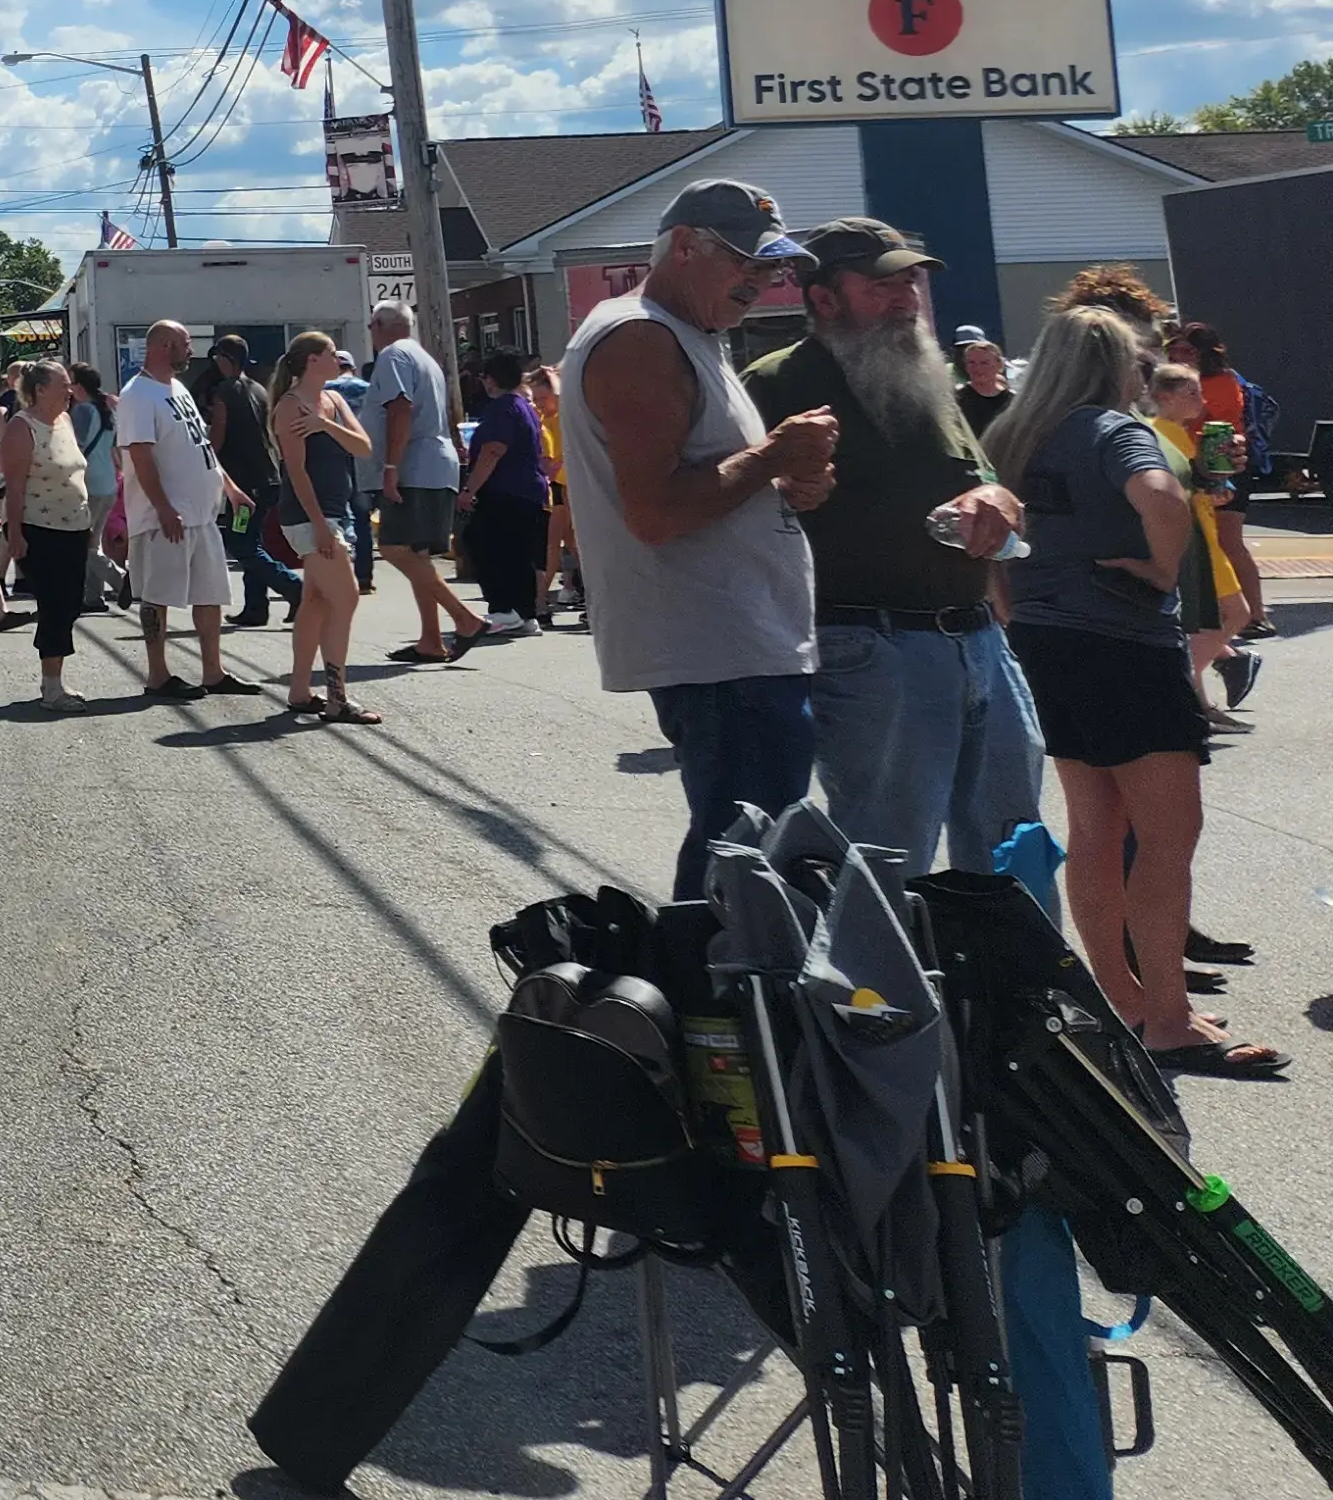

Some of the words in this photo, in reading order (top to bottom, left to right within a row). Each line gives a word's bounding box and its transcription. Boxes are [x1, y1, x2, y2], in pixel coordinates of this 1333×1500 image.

[754, 73, 843, 105] First
[856, 71, 972, 102] State
[982, 65, 1096, 99] Bank
[374, 256, 412, 269] SOUTH
[376, 282, 414, 300] 247
[1245, 1230, 1315, 1302] ROCKER
